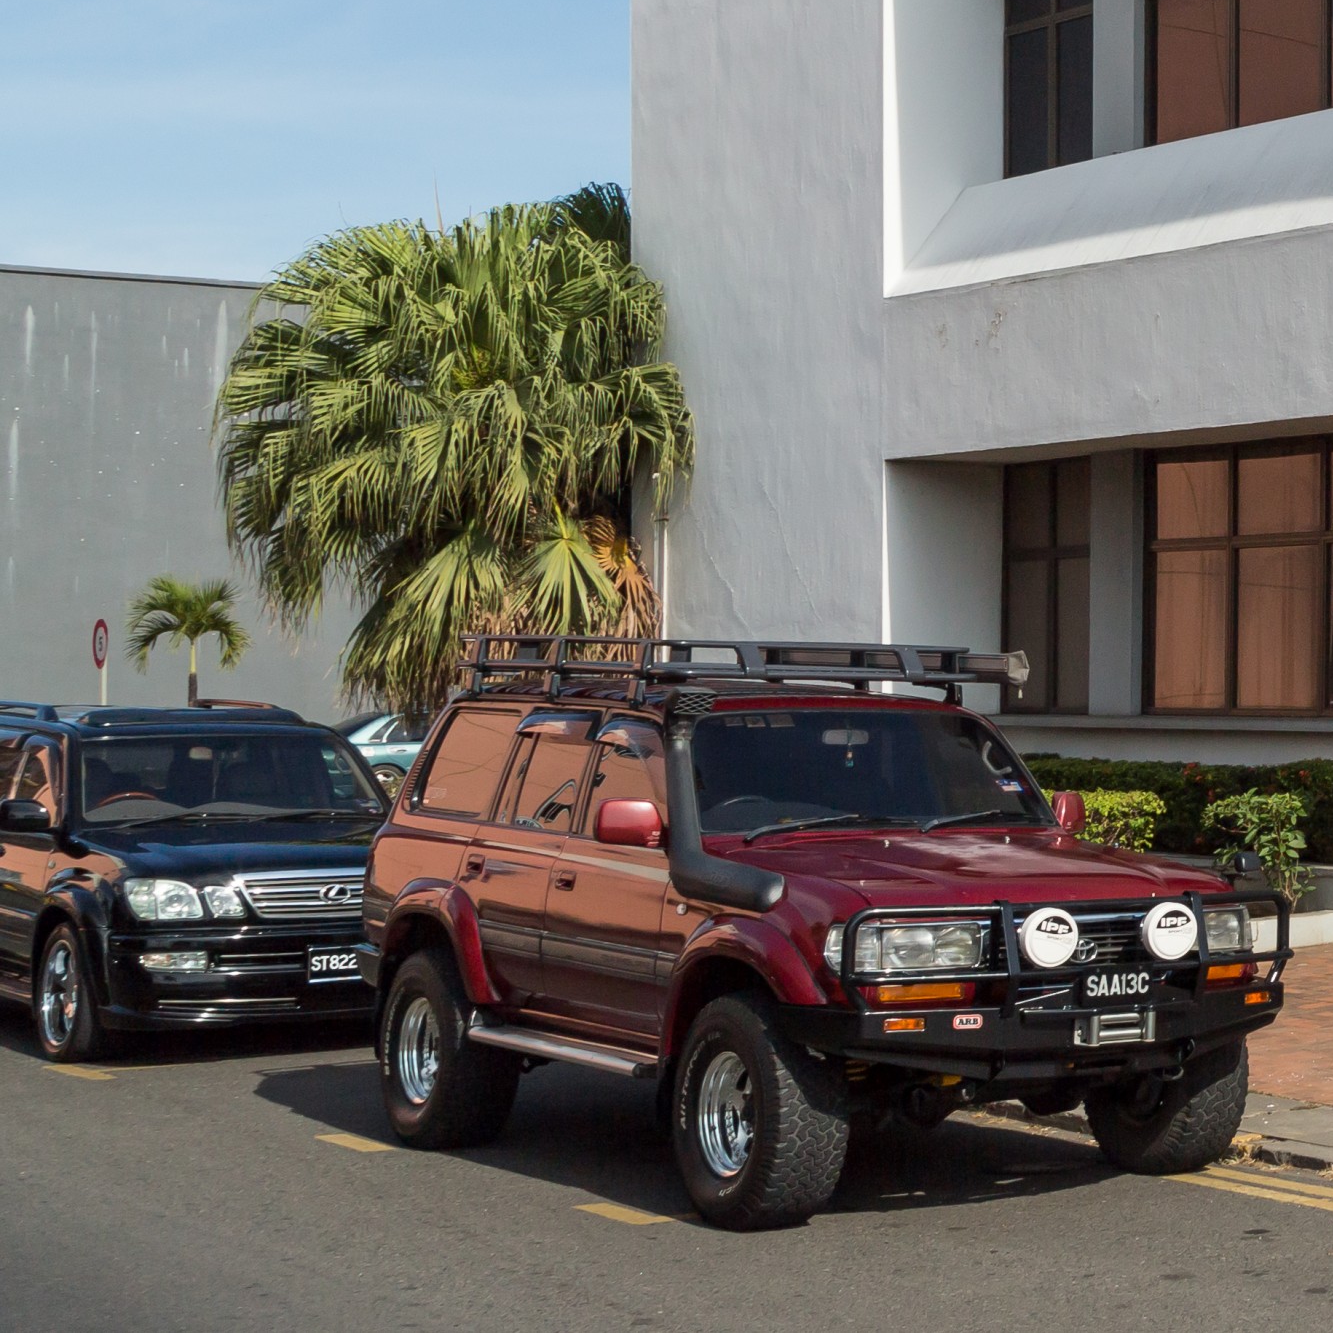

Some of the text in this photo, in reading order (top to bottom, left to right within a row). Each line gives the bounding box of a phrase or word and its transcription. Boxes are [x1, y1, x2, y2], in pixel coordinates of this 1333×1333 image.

[1040, 920, 1070, 934] IPF
[1160, 916, 1188, 927] IPF
[1086, 971, 1150, 997] SAA13C
[957, 1018, 979, 1026] ARB
